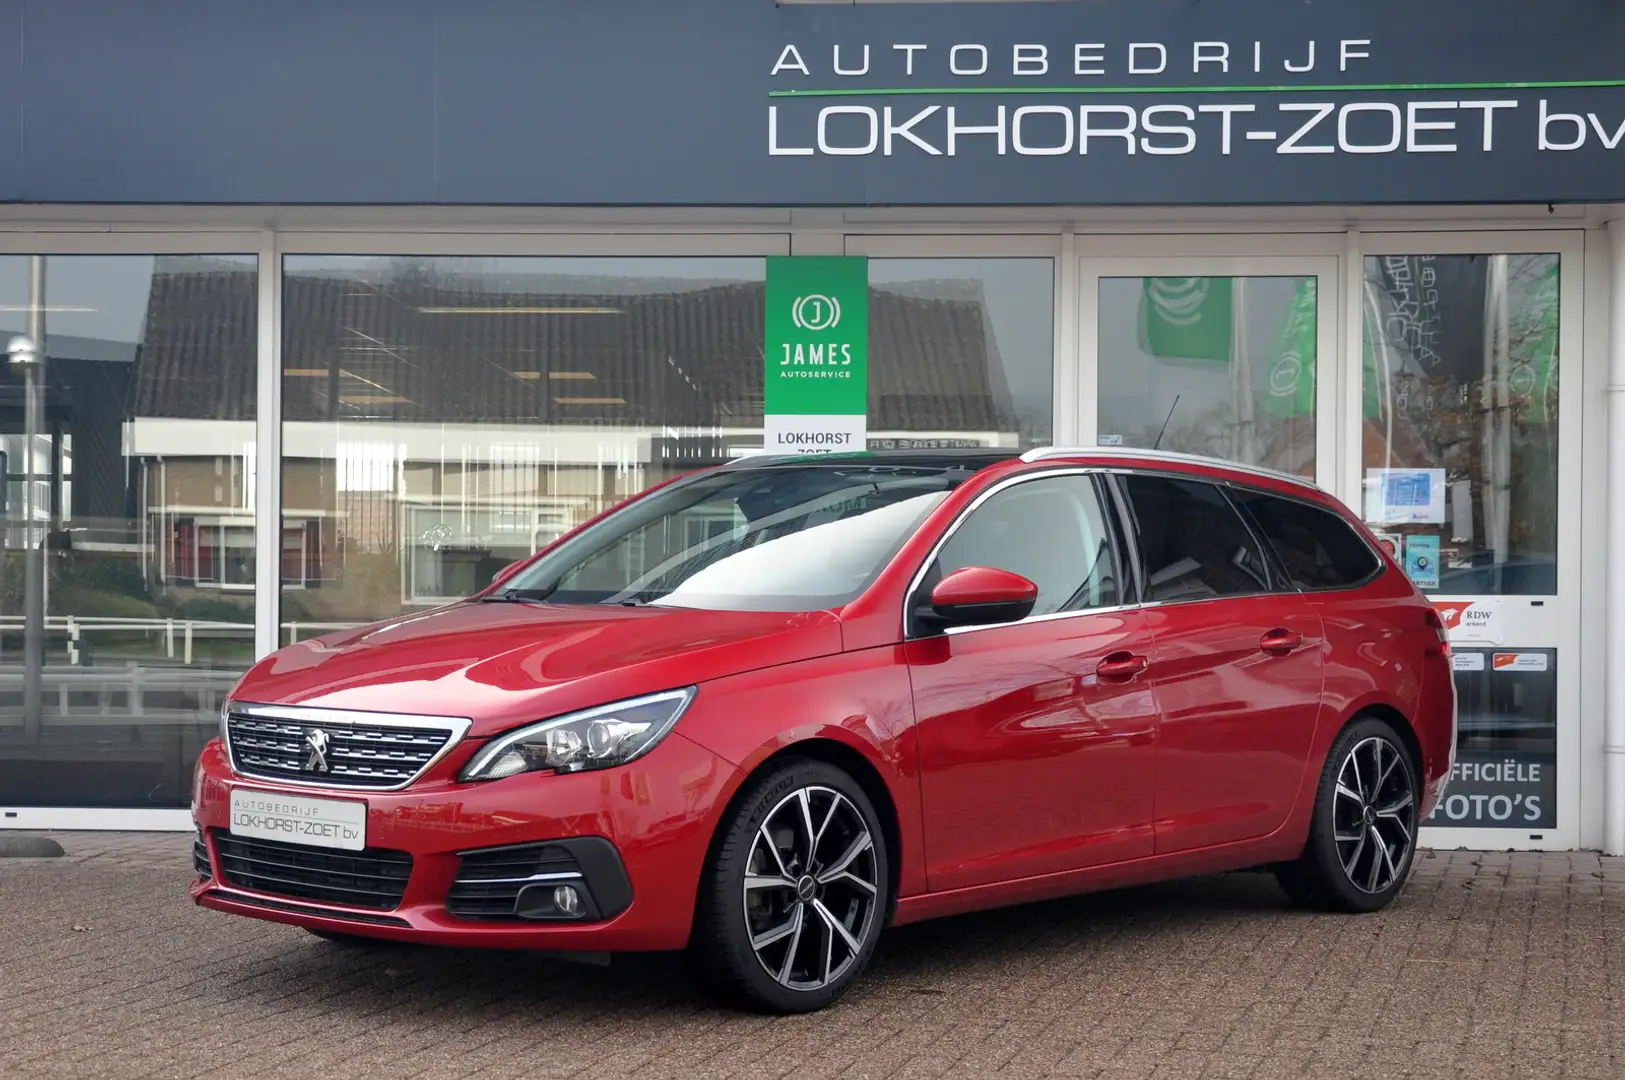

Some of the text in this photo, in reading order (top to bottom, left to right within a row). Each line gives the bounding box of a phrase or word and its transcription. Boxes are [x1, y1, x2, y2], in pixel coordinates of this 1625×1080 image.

[770, 39, 1372, 77] AUTOBEDRIJF
[768, 99, 1625, 156] LOKHORST-ZOET bv
[780, 343, 851, 366] JAMES
[780, 370, 851, 378] AUTOSERVICE
[778, 432, 852, 444] LOKHORST
[1466, 611, 1492, 619] RDW
[1450, 759, 1541, 782] FFICIËLE
[234, 799, 320, 817] AUTOBEDRIJF
[233, 813, 359, 840] LOKHORST-ZOET bv
